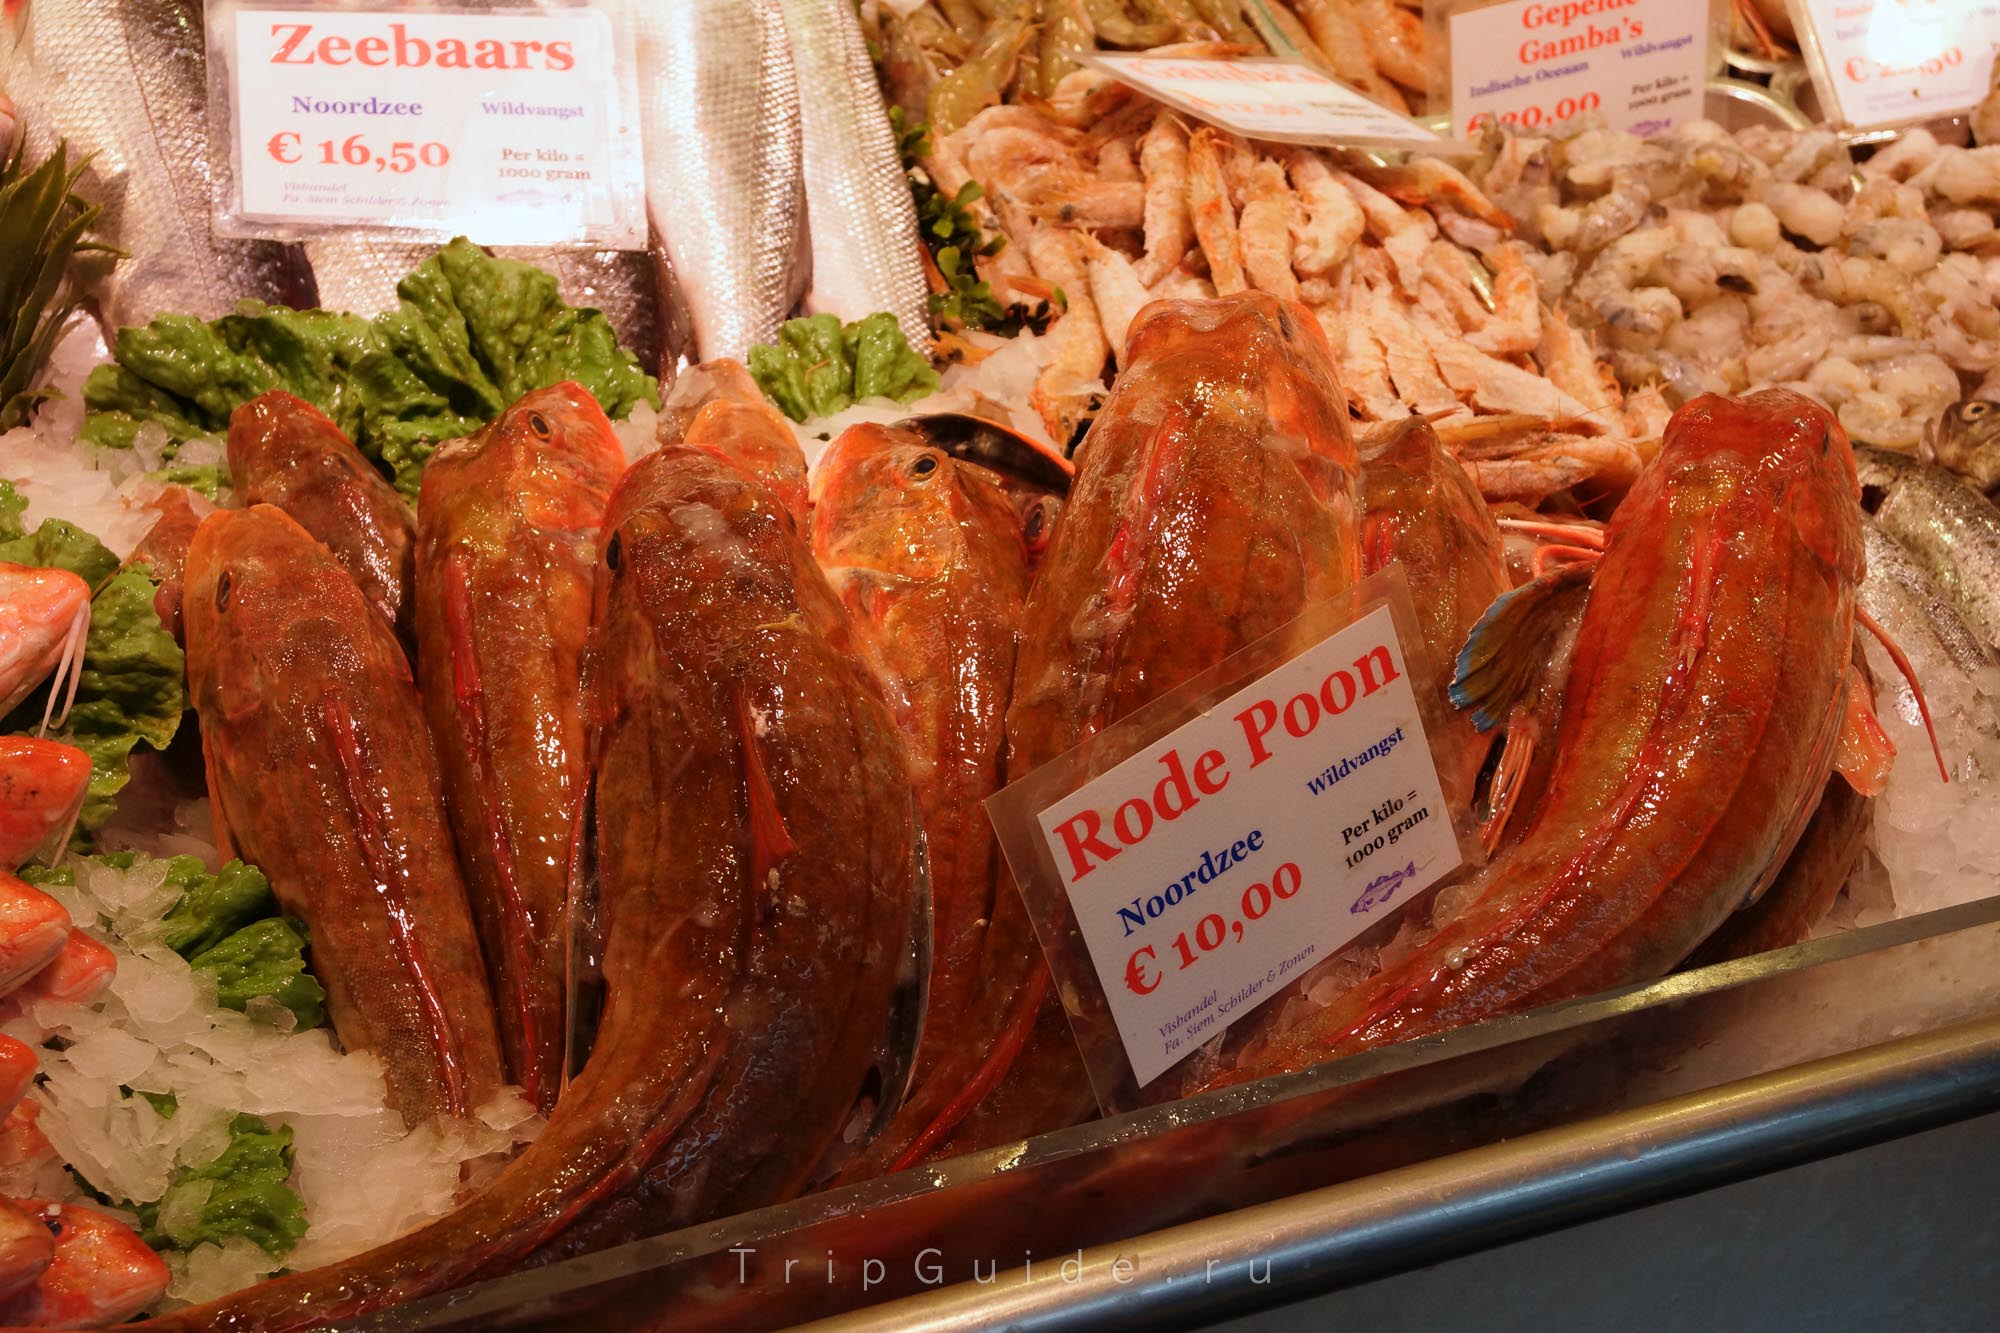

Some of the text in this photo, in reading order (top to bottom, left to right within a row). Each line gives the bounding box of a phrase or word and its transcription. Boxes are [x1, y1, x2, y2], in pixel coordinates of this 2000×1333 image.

[1522, 0, 1640, 30] Gepe
[270, 24, 575, 71] Zeebaars
[1518, 17, 1644, 65] Gamba's
[1469, 61, 1589, 99] Indische Oceaan
[292, 96, 424, 117] Noordzee
[482, 102, 585, 119] Wildvangst
[267, 132, 450, 173] € 16,50
[498, 168, 592, 182] 1000 gram
[502, 148, 531, 161] Per
[536, 148, 569, 162] kilo
[1053, 644, 1401, 883] Rode Poon
[1307, 726, 1405, 796] Wildvangst
[1341, 821, 1370, 846] Per
[1371, 798, 1404, 826] kilo
[1345, 807, 1429, 869] 1000 gram
[1116, 827, 1265, 936] Noordzee
[1123, 862, 1302, 996] € 10,00
[1159, 990, 1218, 1038] Vishandel
[1164, 944, 1315, 1055] Fa. Siem Schilder & Zonen
